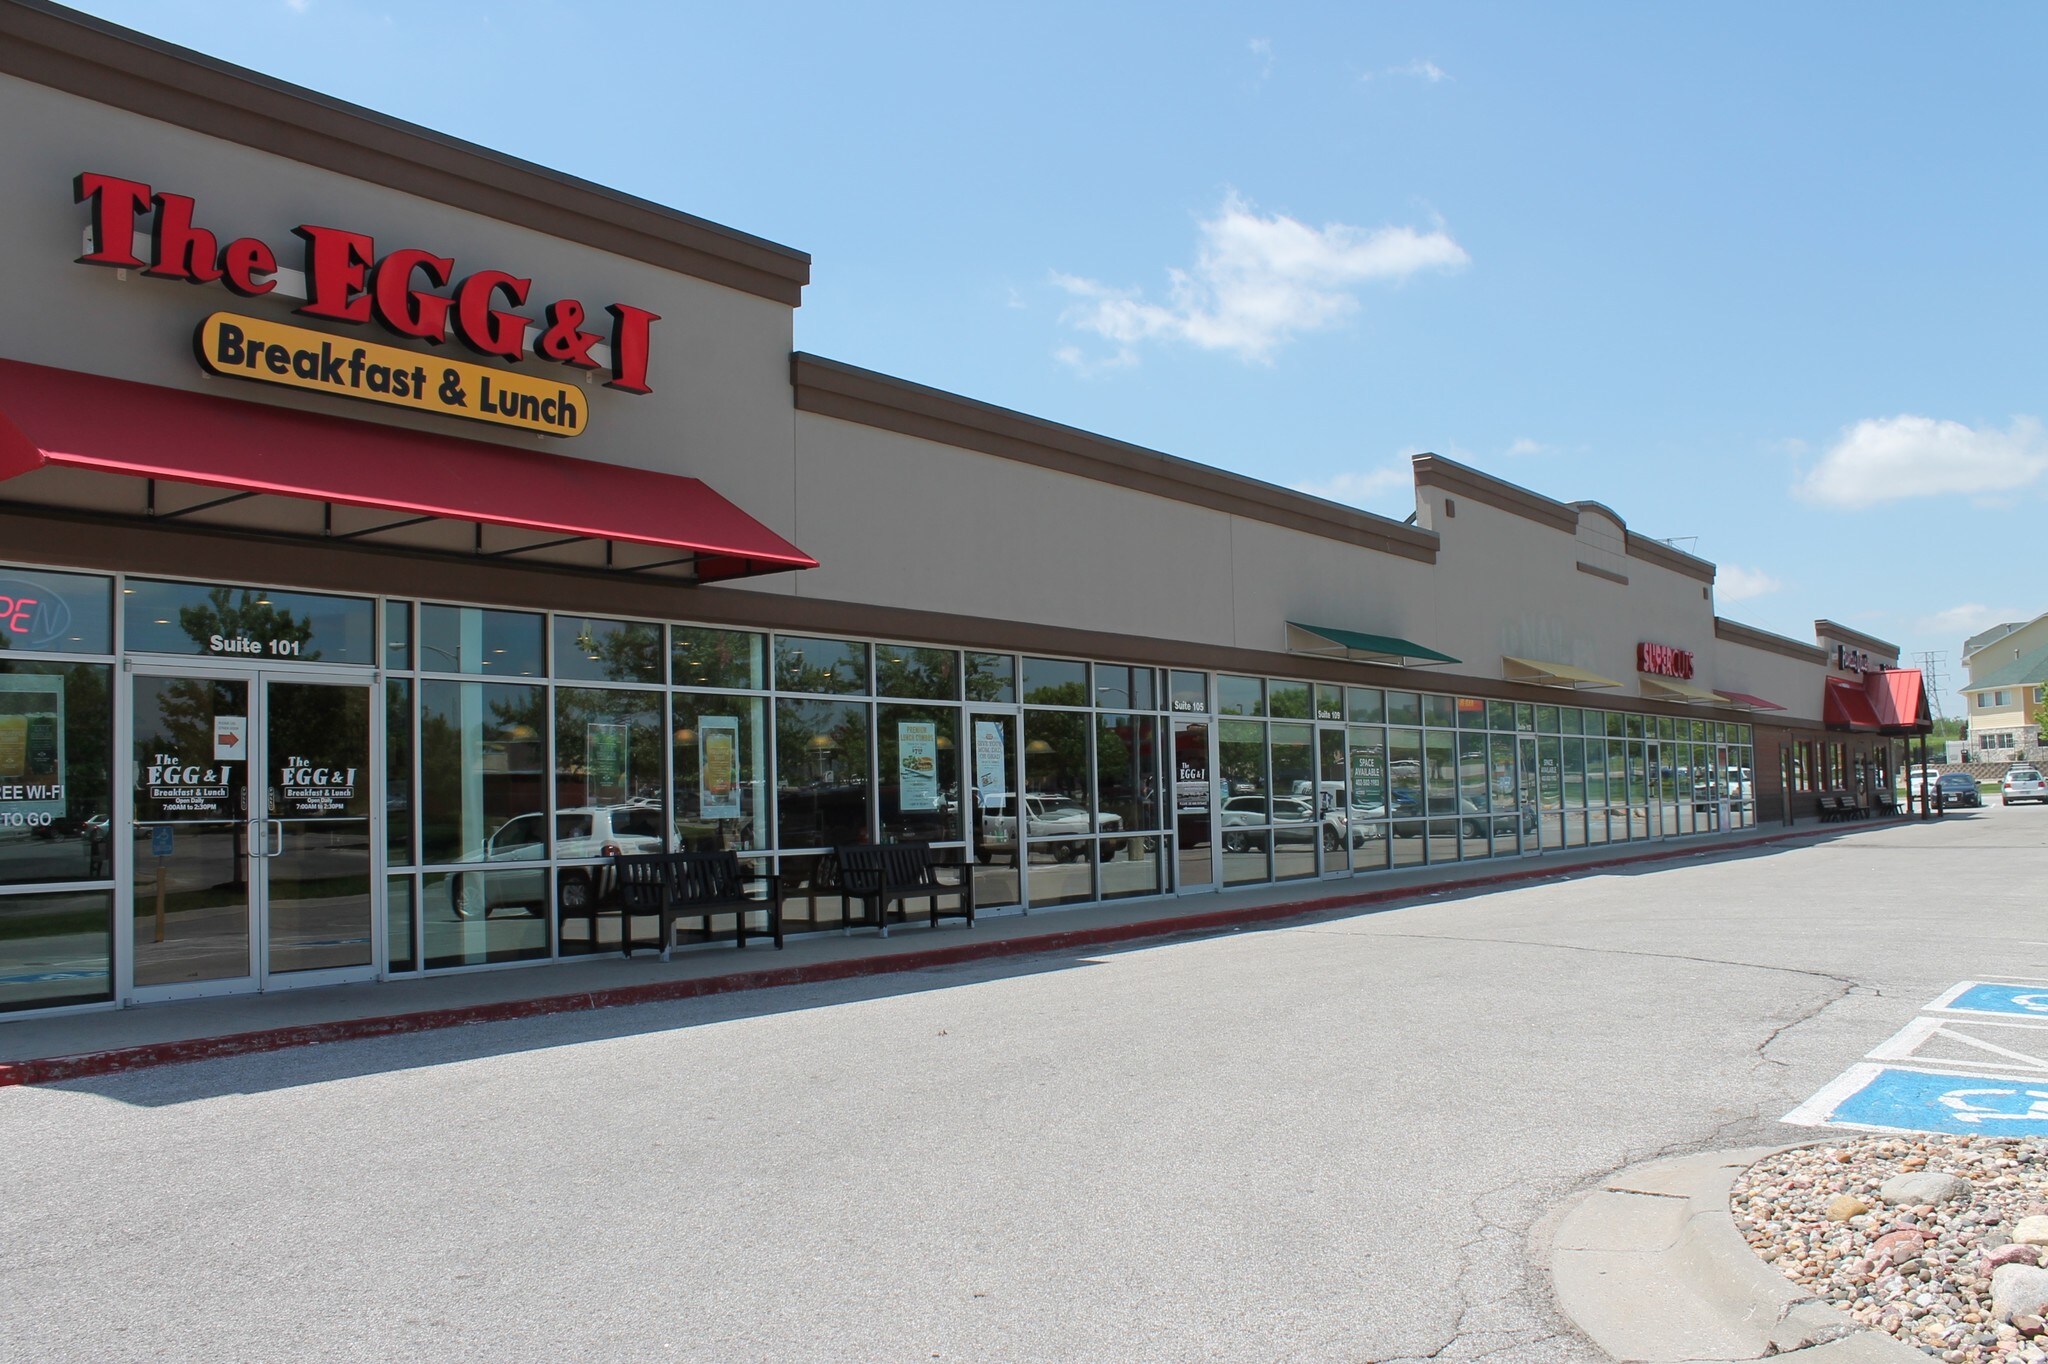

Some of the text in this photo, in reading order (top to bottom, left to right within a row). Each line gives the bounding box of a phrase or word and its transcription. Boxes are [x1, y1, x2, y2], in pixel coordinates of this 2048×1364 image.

[73, 171, 661, 395] The EGG & I
[217, 322, 578, 429] Breakfast & Lunch
[210, 634, 299, 656] Suite 101
[1174, 700, 1204, 711] Suite 105
[1318, 709, 1330, 718] Suite
[155, 754, 179, 765] The
[288, 756, 310, 767] The
[1359, 758, 1374, 767] SPACE
[146, 766, 232, 785] EGG & I
[281, 768, 357, 786] EGG & I
[1180, 769, 1196, 779] EGG
[1196, 770, 1201, 778] &
[1355, 768, 1380, 776] AVAILABLE
[26, 785, 65, 799] WI-FI
[153, 788, 226, 796] Breakfast & Lunch
[1, 812, 52, 826] TO GO
